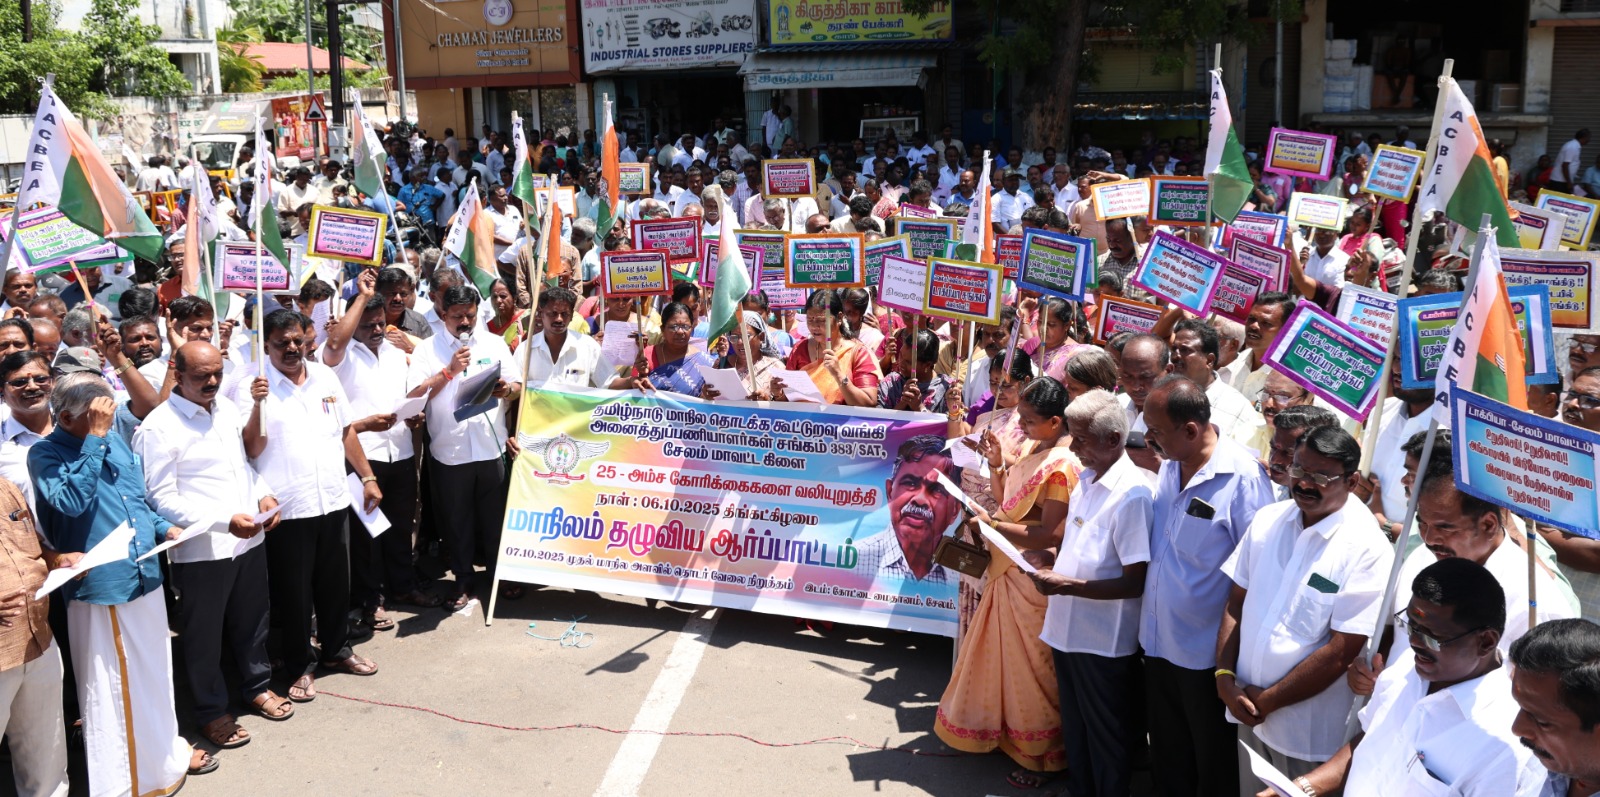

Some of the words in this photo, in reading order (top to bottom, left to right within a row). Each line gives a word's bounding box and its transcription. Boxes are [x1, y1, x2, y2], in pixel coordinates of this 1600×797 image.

[437, 31, 487, 47] CHAMAN
[490, 27, 562, 45] JEWELLERS
[590, 48, 650, 62] INDUSTRIAL
[652, 45, 692, 58] STORES
[694, 42, 754, 55] SUPPLIERS
[1332, 364, 1366, 390] சங்கம்
[589, 418, 774, 449] அனைத்துப்பணியாளர்கள்
[776, 437, 827, 453] சங்கம்
[593, 404, 663, 421] தமிழ்நாடு
[665, 408, 707, 427] மாநில
[709, 413, 770, 431] தொடக்க
[773, 418, 839, 440] கூட்டுறவு
[841, 423, 885, 440] வங்கி
[1468, 405, 1507, 427] டாக்பியா
[1544, 432, 1593, 453] மாவட்டம்
[663, 441, 709, 460] சேலம்
[711, 446, 760, 465] மாவட்ட
[763, 452, 806, 470] கிளை
[596, 464, 616, 480] 25
[627, 467, 666, 484] அம்ச
[669, 470, 792, 497] கோரிக்கைகளை
[795, 484, 877, 507] வலியுறுத்தி
[595, 491, 632, 507] நாள்
[641, 497, 720, 516] 06.10.2025
[722, 503, 818, 527] திங்கட்கிழமை
[506, 506, 604, 543] மாநிலம்
[606, 519, 705, 557] தழுவிய
[709, 526, 859, 570] ஆர்ப்பாட்டம்
[505, 546, 564, 563] 07.10.2025
[565, 554, 595, 567] முதல்
[596, 557, 629, 571] மாநில
[630, 561, 673, 576] அளவில்
[673, 564, 709, 580] தொடர்
[710, 570, 746, 585] வேலை
[747, 573, 795, 591] நிறுத்தம்
[832, 586, 872, 600] கோட்டை
